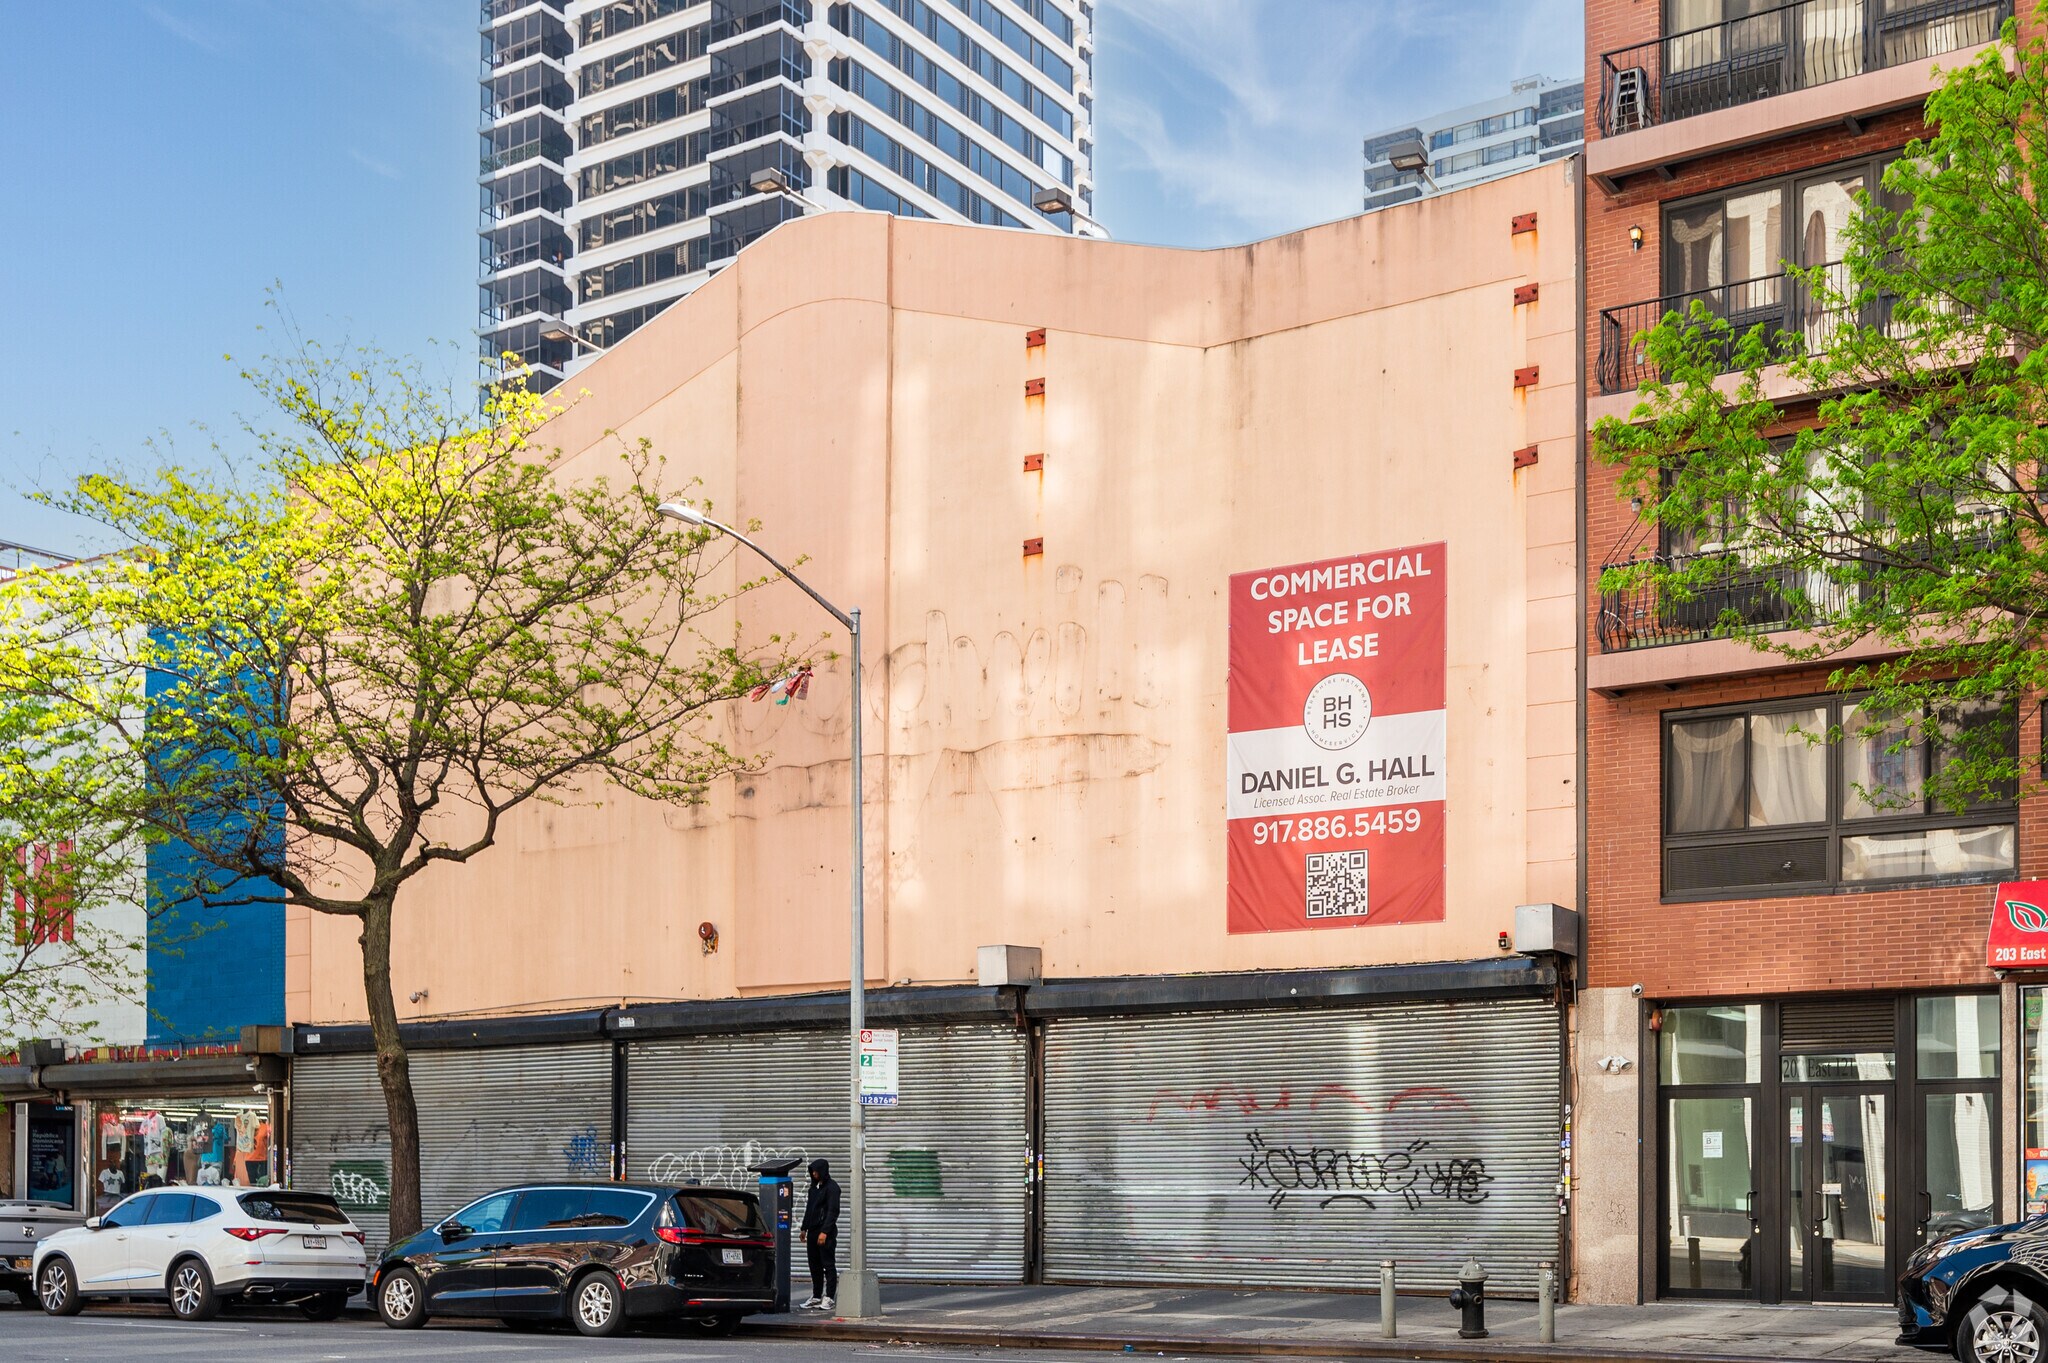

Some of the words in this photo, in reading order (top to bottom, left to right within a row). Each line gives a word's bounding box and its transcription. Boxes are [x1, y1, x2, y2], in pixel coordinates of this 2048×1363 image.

[1250, 553, 1431, 601] COMMERCIAL
[1268, 601, 1348, 634] SPACE
[1356, 592, 1411, 623] FOR
[1298, 632, 1379, 666] LEASE
[1307, 678, 1336, 715] BERKSHIRE
[1340, 677, 1368, 709] HATHAWAY
[1323, 694, 1352, 712] BH
[1323, 712, 1352, 730] HS
[1311, 724, 1363, 746] HOMESERVICES
[1241, 765, 1329, 795] DANIEL
[1336, 762, 1361, 786] G.
[1368, 754, 1435, 783] HALL
[1253, 794, 1297, 809] Licensed
[1297, 792, 1327, 805] Assoc.
[1330, 789, 1351, 802] Real
[1354, 786, 1384, 800] Estate
[1386, 783, 1420, 796] Broker
[1253, 808, 1421, 845] 917.886.5459
[1995, 948, 2016, 961] 203
[2020, 947, 2046, 960] East
[863, 1056, 870, 1066] 2
[1808, 1058, 1831, 1078] East
